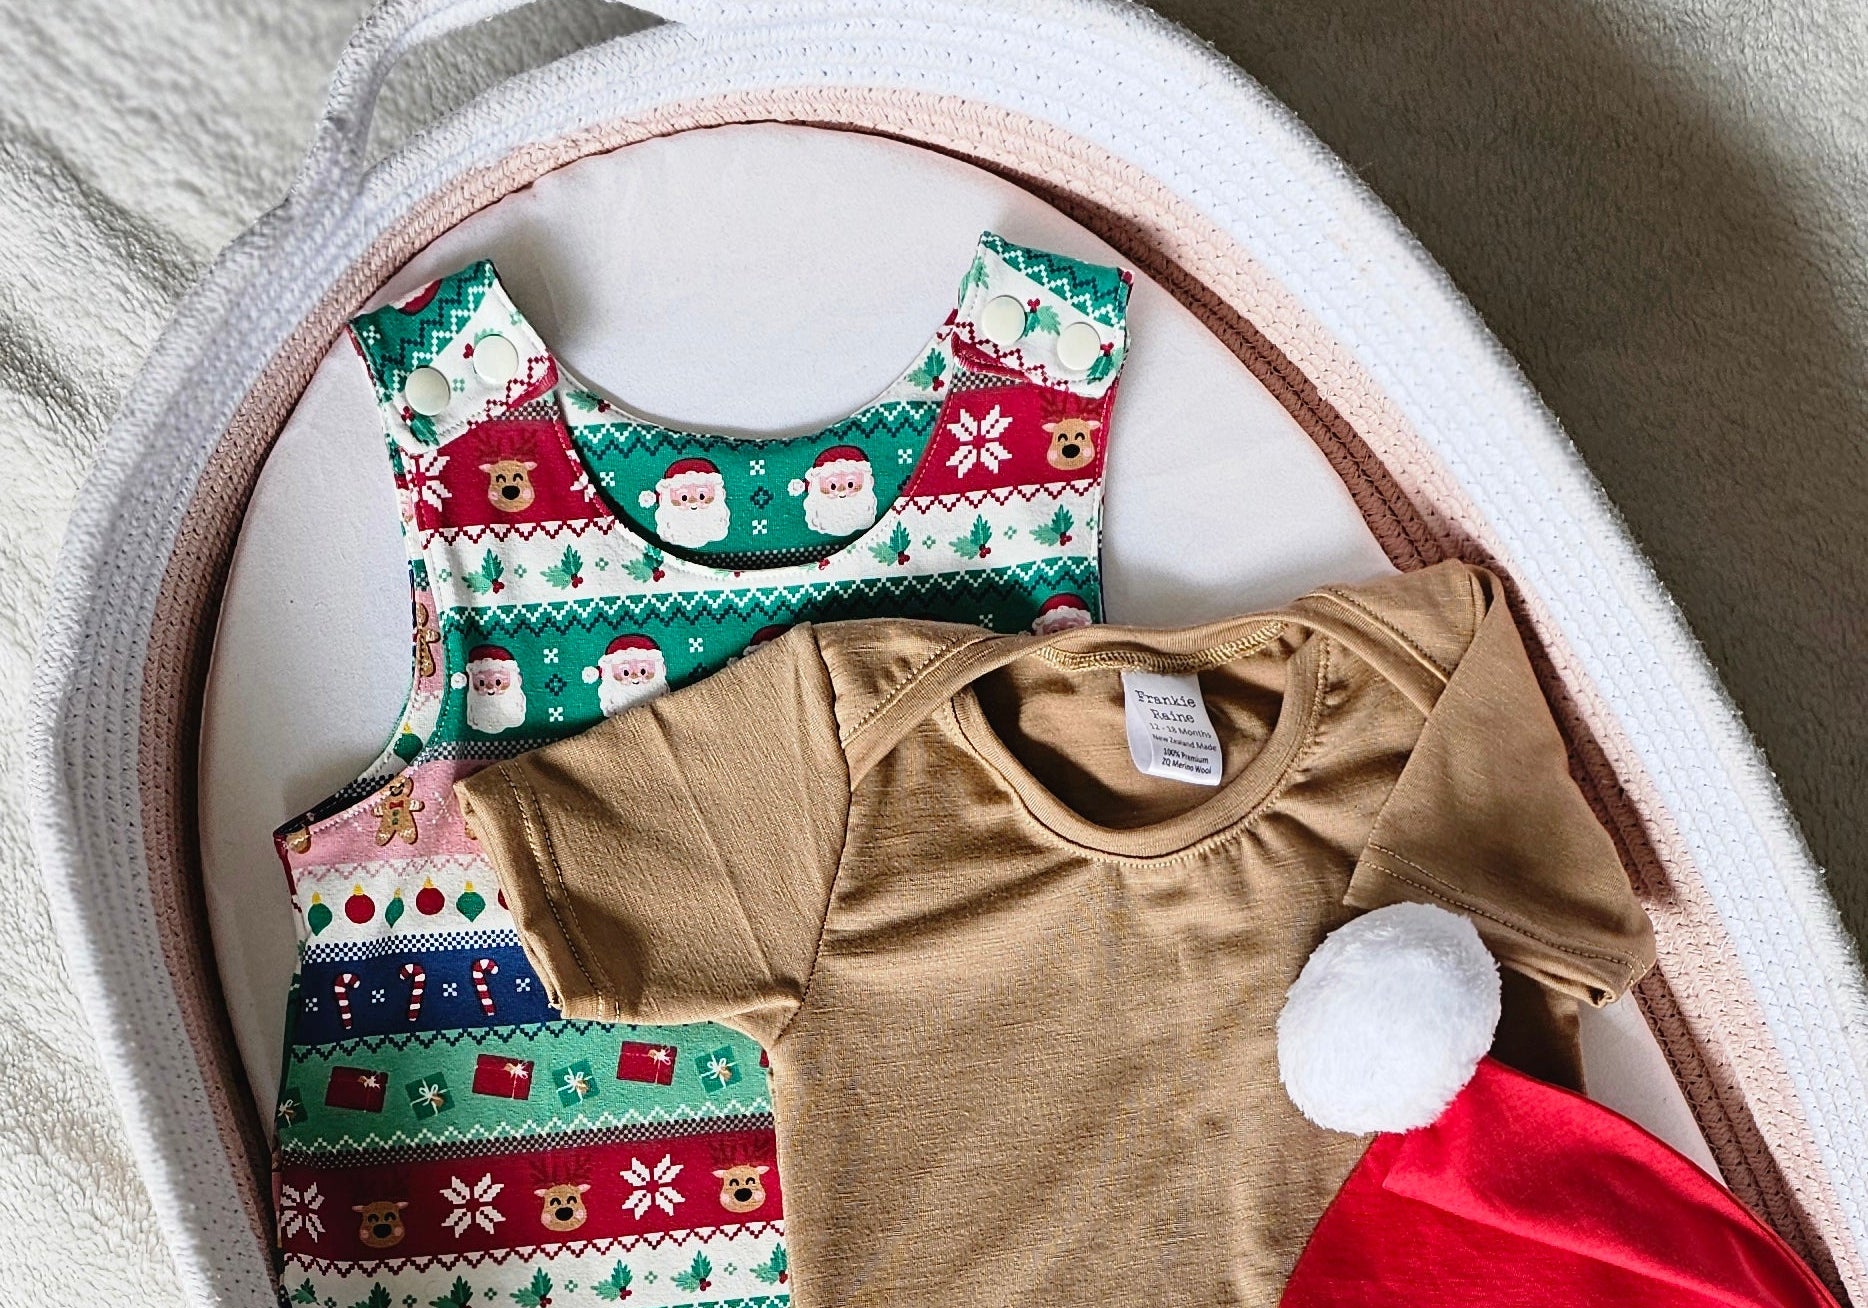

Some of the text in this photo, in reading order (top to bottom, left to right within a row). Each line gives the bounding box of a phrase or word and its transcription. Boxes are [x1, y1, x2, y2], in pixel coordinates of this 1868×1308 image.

[1135, 689, 1196, 708] Frankie
[1150, 708, 1195, 723] Raine
[1150, 722, 1160, 731] 12
[1179, 728, 1212, 739] Months
[1152, 734, 1217, 752] New Zealand Made
[1163, 747, 1209, 764] 100% Premium
[1172, 760, 1194, 772] Merino
[1195, 766, 1212, 774] Wool
